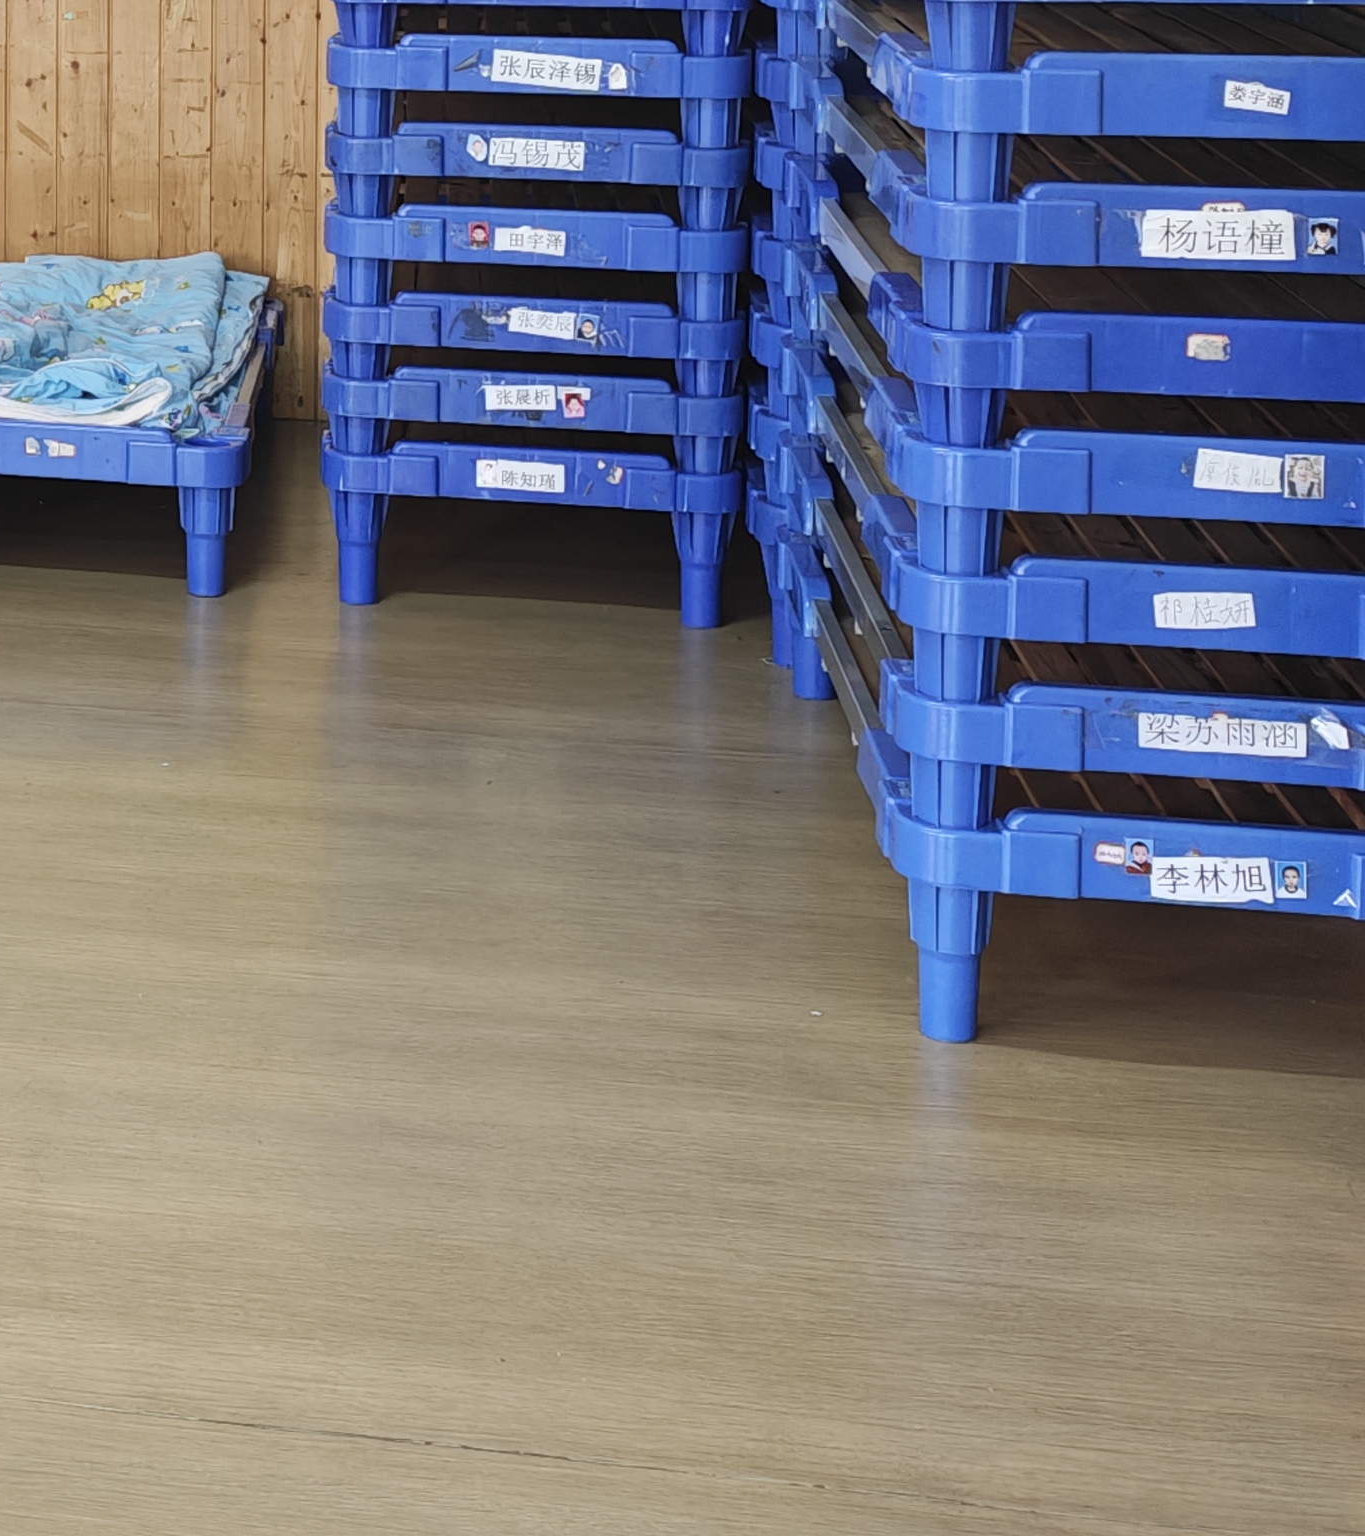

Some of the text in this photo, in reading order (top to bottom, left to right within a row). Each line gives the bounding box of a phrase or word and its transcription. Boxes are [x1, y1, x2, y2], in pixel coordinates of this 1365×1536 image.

[499, 55, 597, 85] 张辰泽锡
[492, 140, 582, 169] 冯锡茂
[509, 232, 564, 250] 田宇泽
[1158, 217, 1286, 255] 杨语橦
[517, 311, 573, 332] 张奕辰
[1145, 714, 1298, 750] 梁苏雨涵
[1156, 863, 1267, 895] 李林旭
